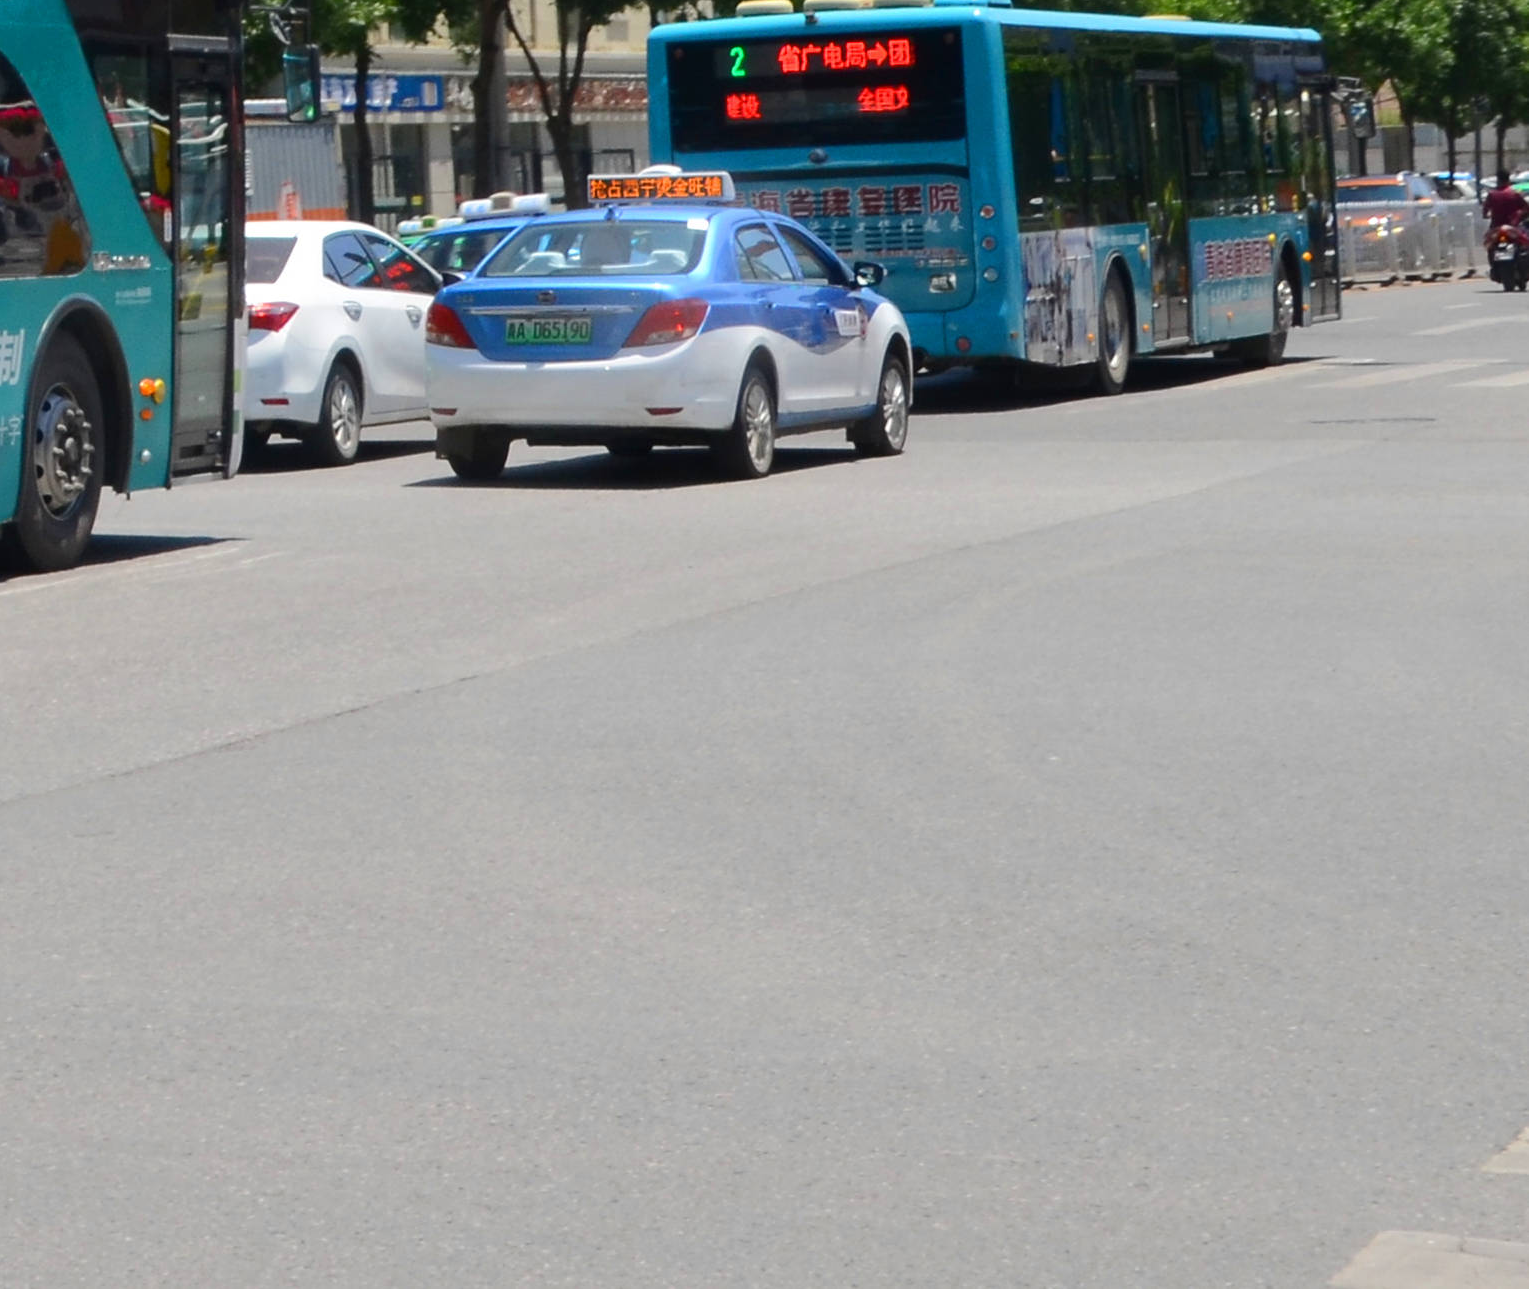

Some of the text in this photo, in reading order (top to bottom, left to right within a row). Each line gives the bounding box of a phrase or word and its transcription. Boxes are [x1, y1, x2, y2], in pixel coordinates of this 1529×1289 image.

[730, 46, 746, 77] 2
[736, 184, 961, 218] 海省康复医院
